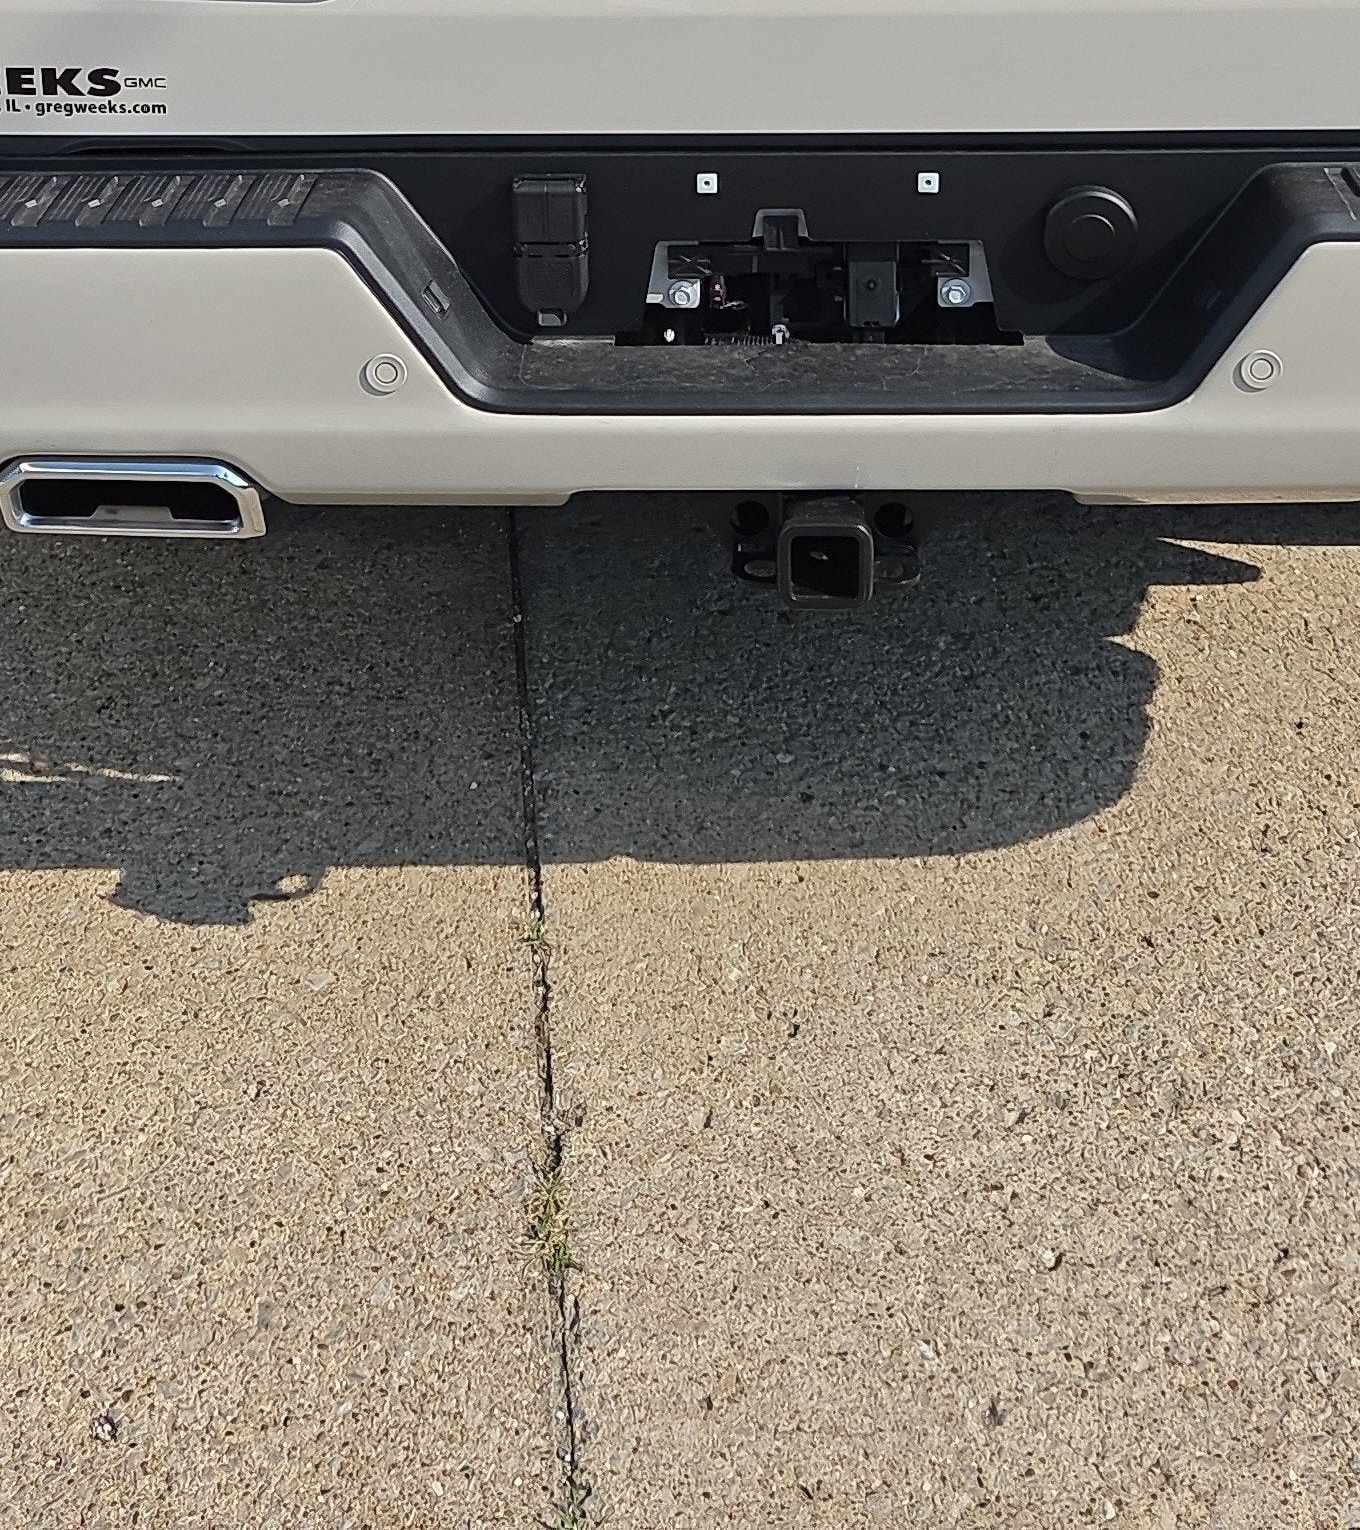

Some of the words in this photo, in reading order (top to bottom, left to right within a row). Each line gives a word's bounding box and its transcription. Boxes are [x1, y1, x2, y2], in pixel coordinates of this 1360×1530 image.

[123, 76, 167, 89] GMC
[5, 98, 22, 113] IL
[35, 99, 167, 117] gregweeks.com
